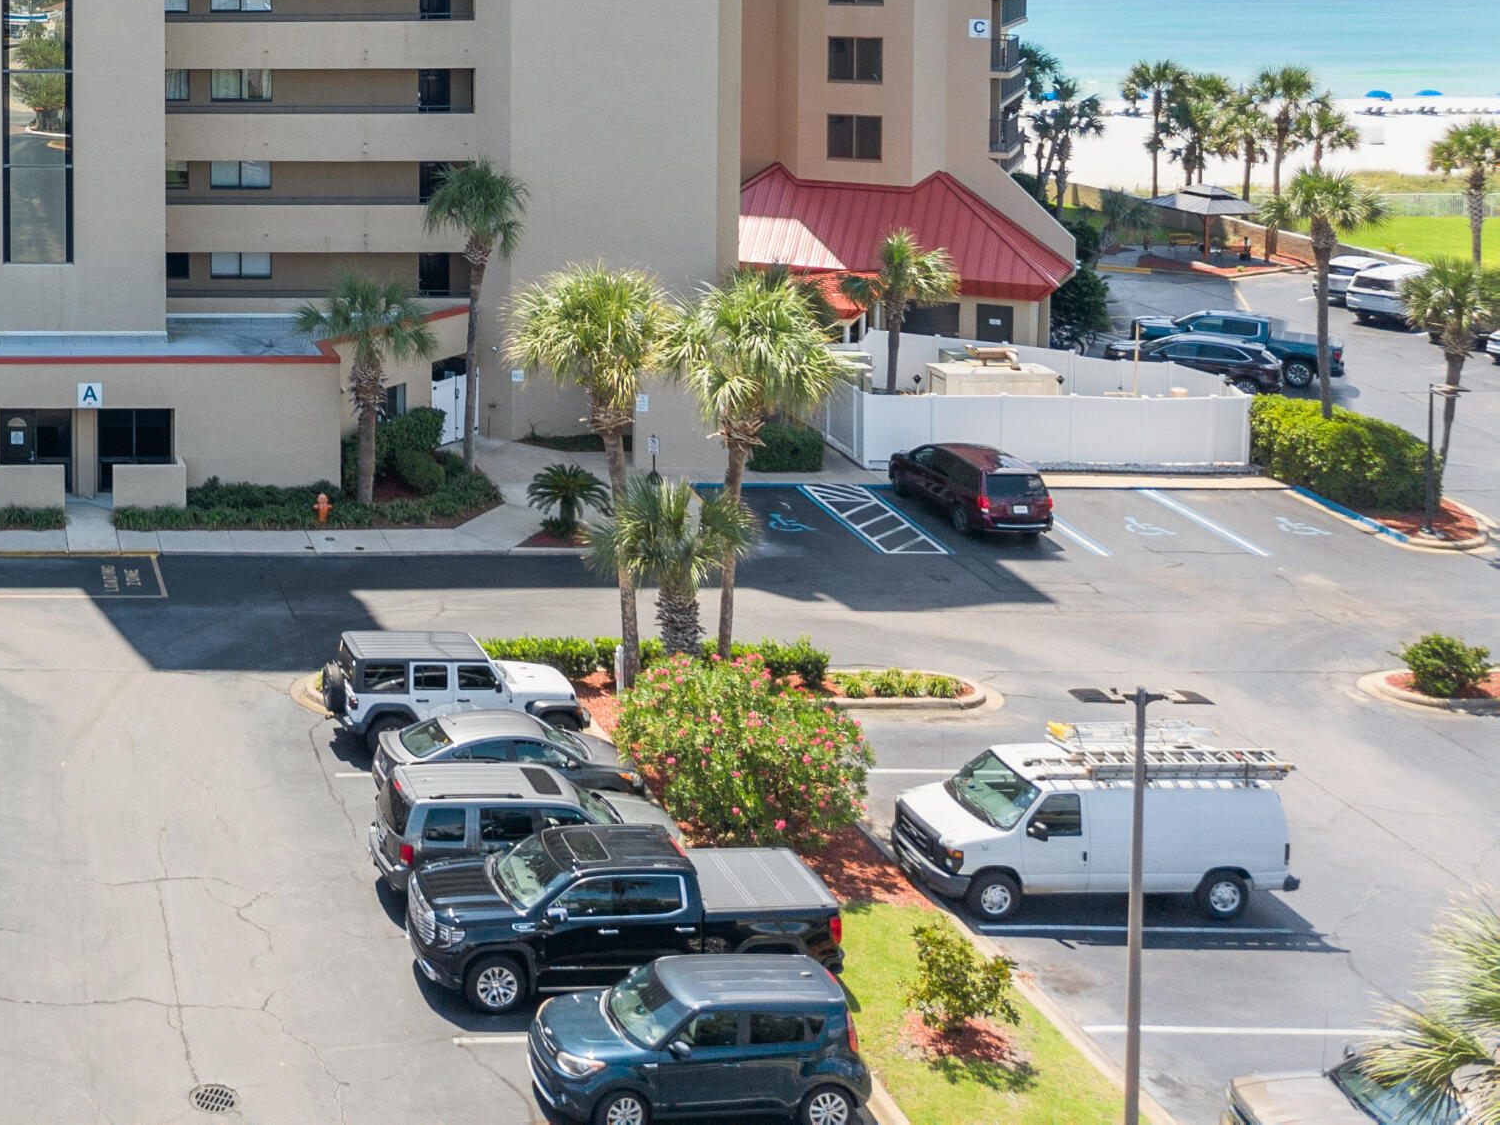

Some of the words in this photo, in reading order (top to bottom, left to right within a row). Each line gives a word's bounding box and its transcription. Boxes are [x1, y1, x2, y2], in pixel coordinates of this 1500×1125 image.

[973, 20, 985, 34] C
[82, 385, 98, 403] A
[124, 569, 141, 586] ZONE
